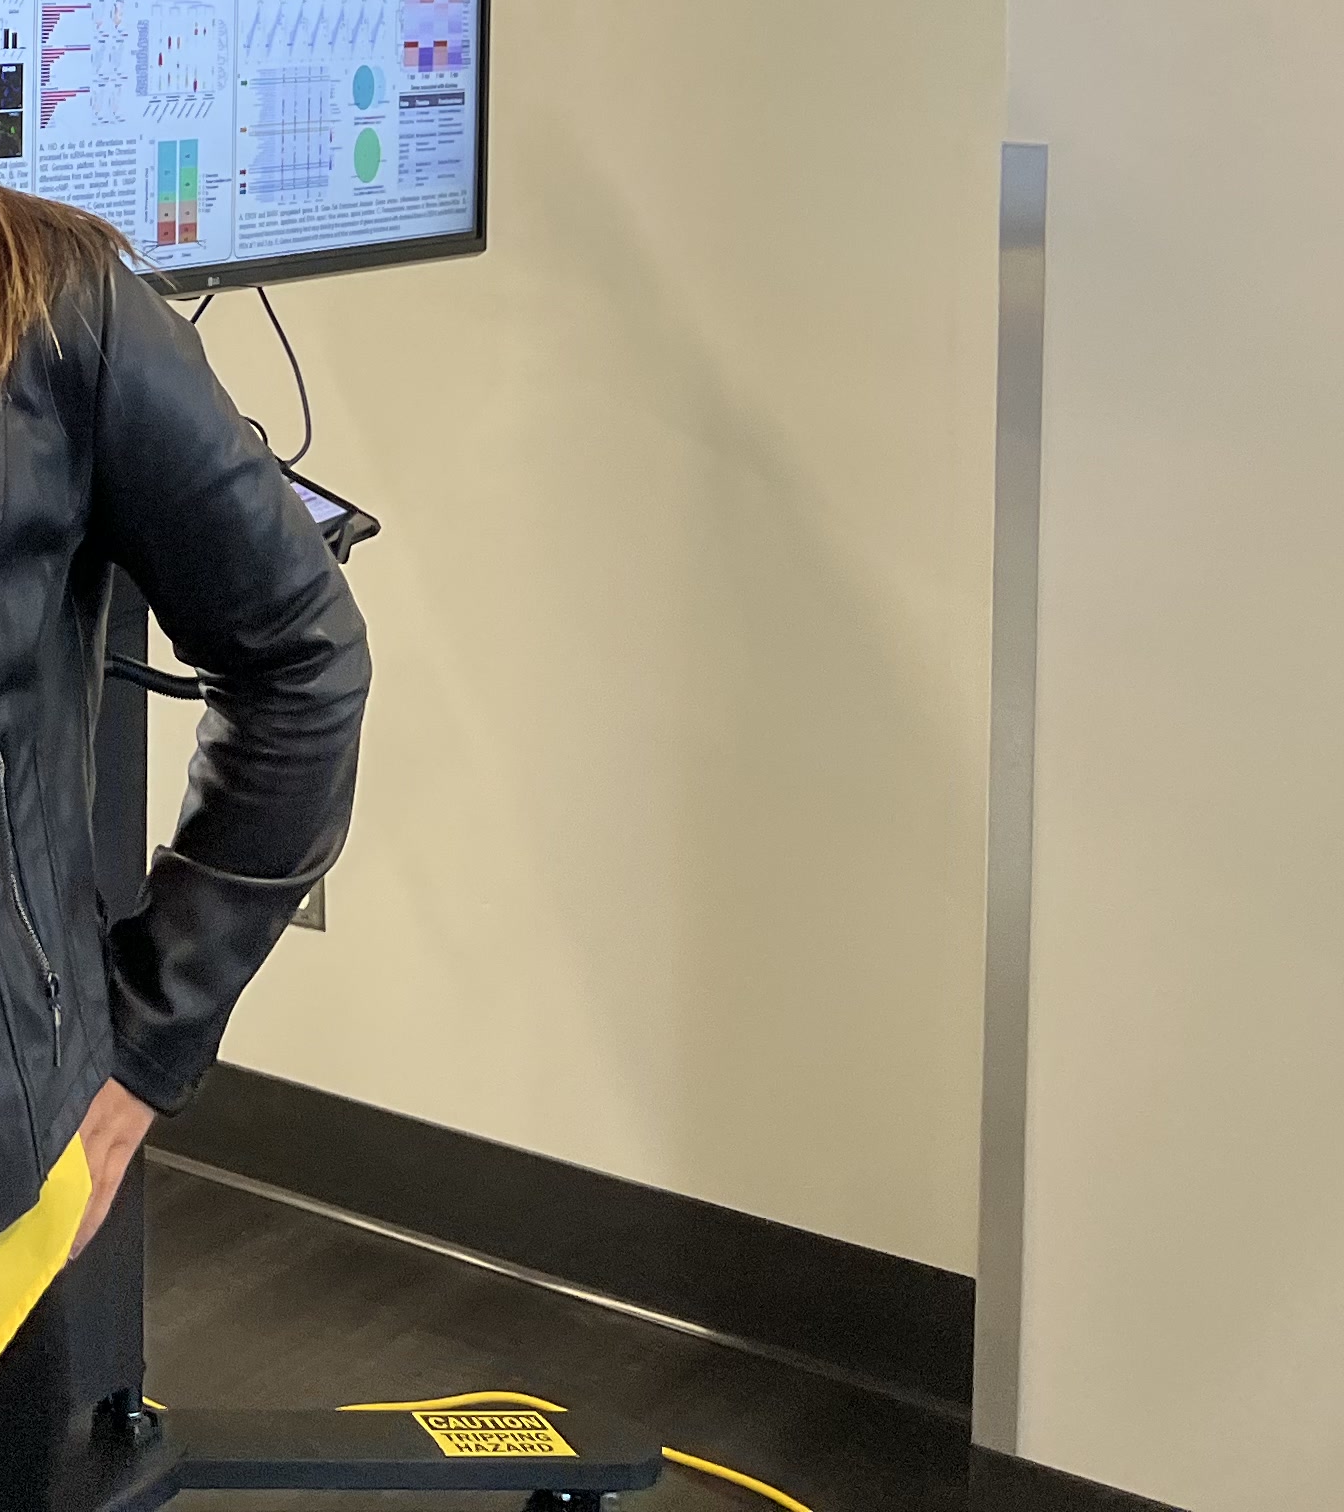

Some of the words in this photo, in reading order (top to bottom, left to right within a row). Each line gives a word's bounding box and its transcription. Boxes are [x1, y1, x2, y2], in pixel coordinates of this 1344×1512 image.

[428, 1416, 544, 1430] CAUTION
[440, 1432, 553, 1443] TRIPPING
[455, 1442, 554, 1454] HAZARD
